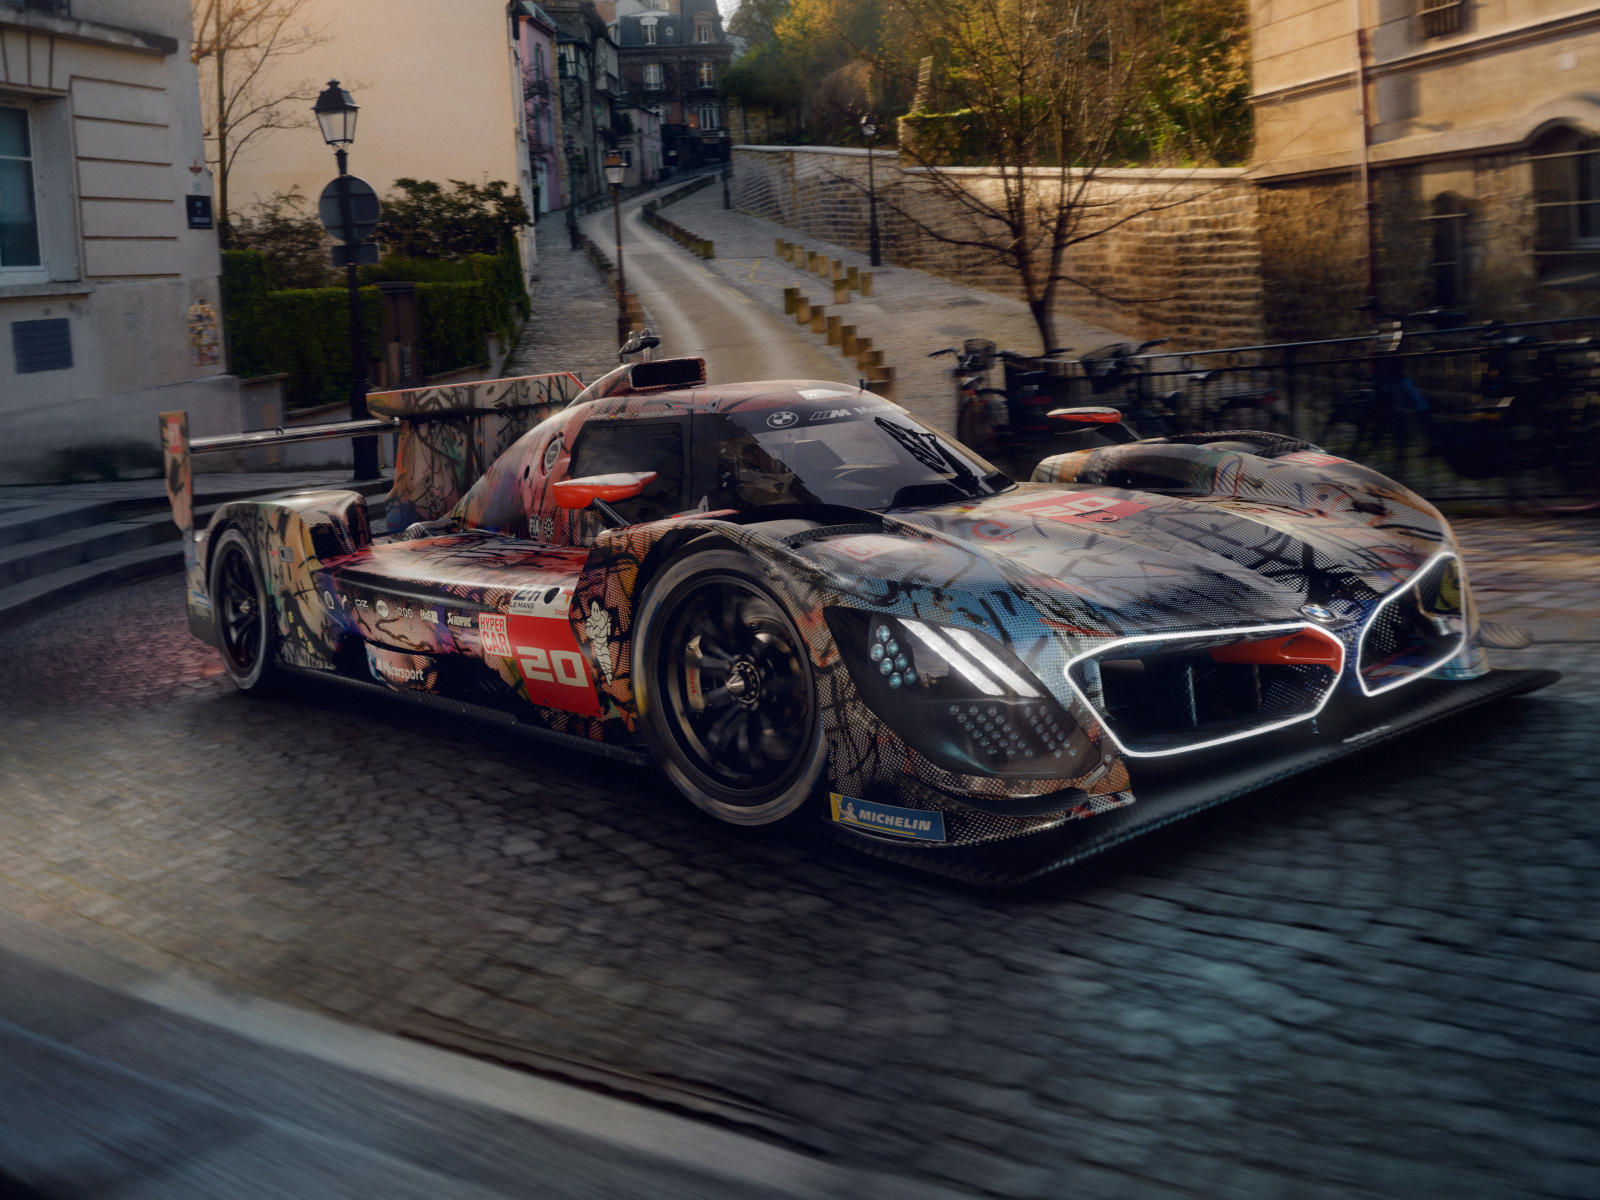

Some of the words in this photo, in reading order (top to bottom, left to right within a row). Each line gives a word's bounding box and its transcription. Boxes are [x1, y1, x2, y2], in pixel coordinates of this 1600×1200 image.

[480, 617, 505, 633] HYPER
[483, 631, 509, 654] CAR
[382, 660, 424, 682] Motorsport
[516, 646, 589, 688] 20
[859, 809, 932, 831] MICHELIN
